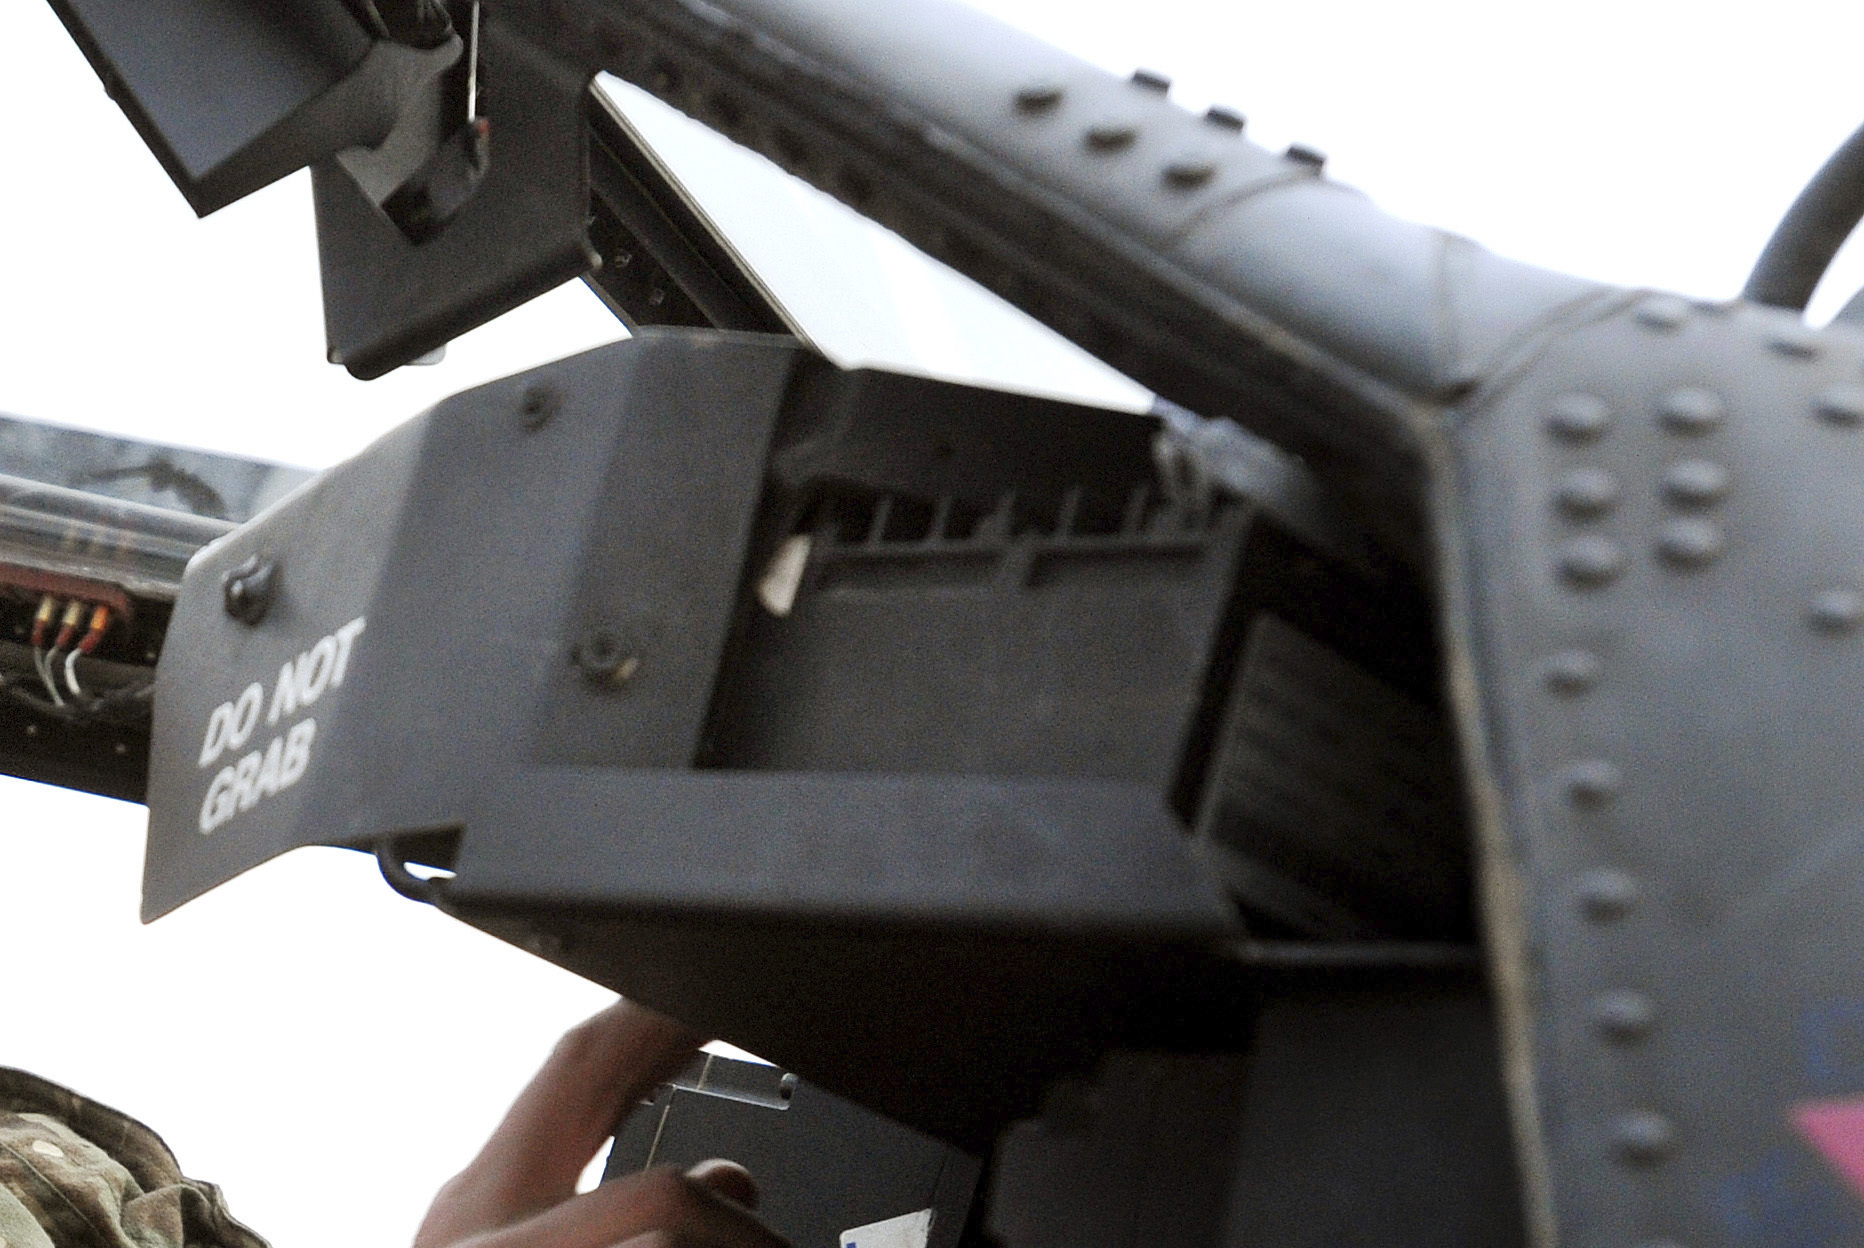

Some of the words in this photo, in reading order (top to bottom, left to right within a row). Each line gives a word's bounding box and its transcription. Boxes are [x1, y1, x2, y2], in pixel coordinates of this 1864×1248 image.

[199, 682, 264, 768] DO
[267, 615, 367, 725] NOT
[199, 717, 317, 835] GRAB
